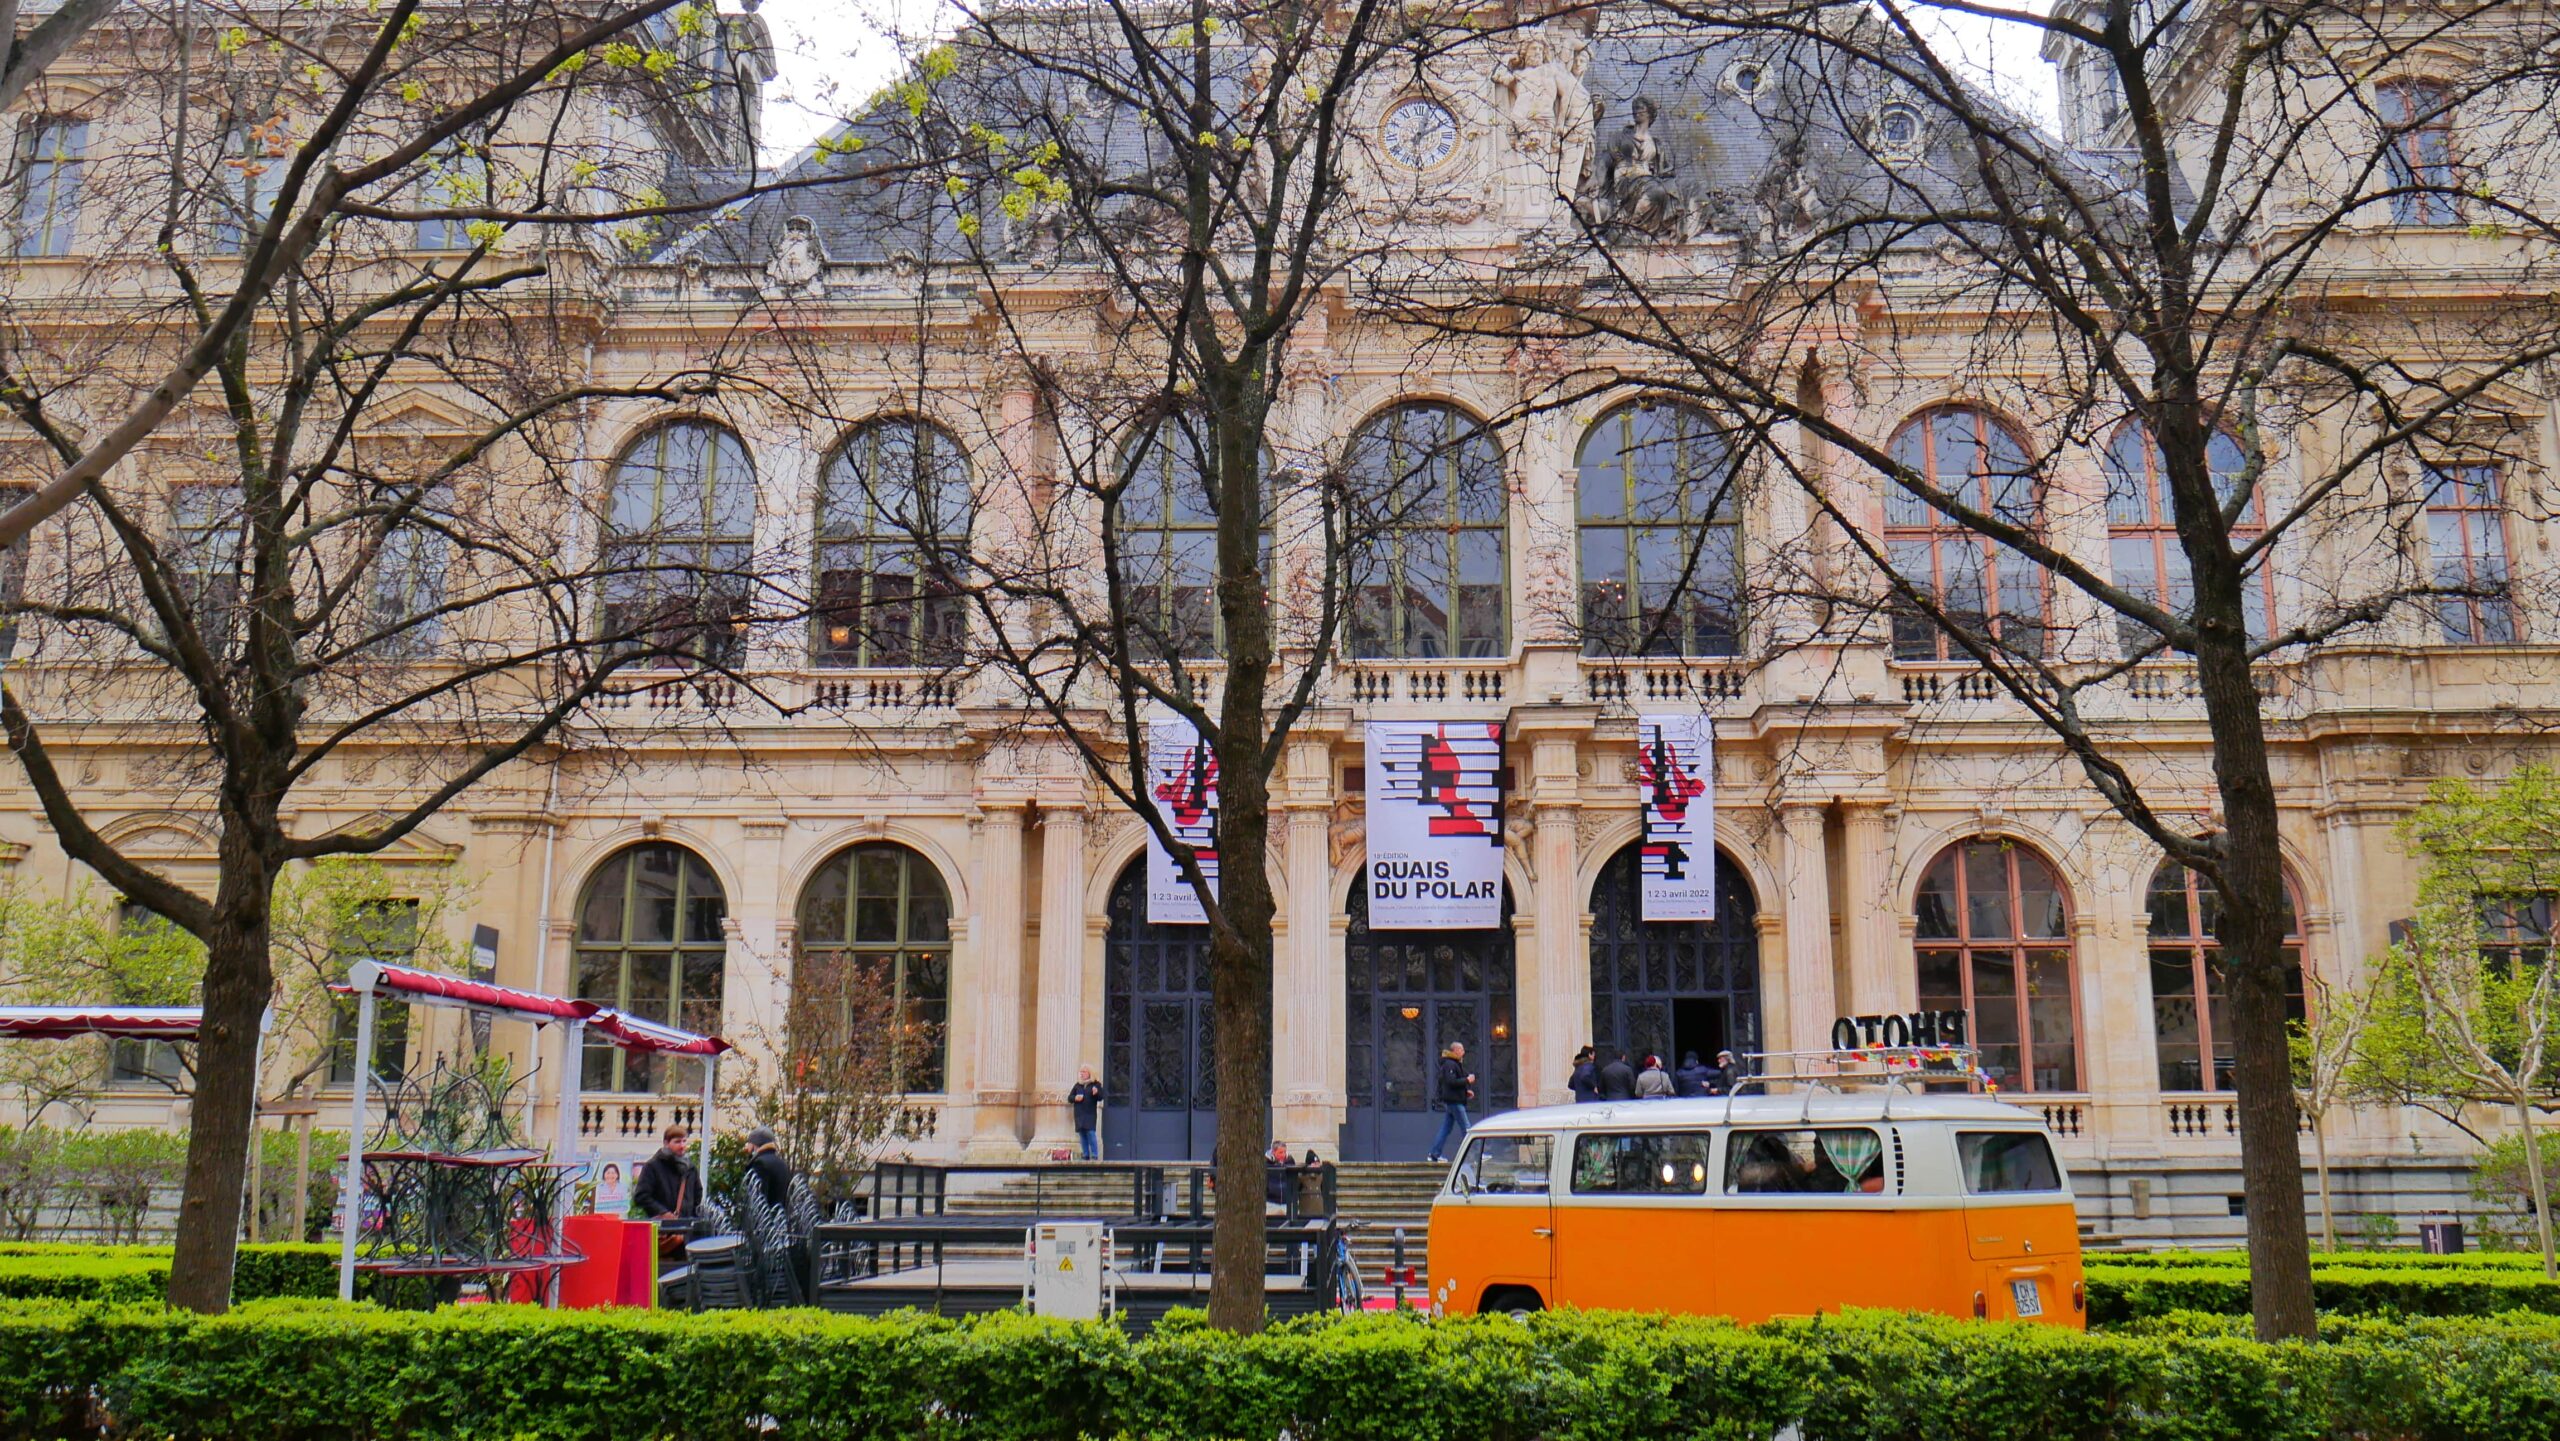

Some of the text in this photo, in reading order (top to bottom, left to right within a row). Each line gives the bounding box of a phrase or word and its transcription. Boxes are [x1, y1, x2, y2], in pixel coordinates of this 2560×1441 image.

[1413, 105, 1425, 117] XII
[1441, 130, 1453, 140] III
[1374, 861, 1449, 880] QUAIS
[1375, 881, 1495, 899] DU POLAR
[1669, 890, 1687, 898] avril
[1689, 890, 1709, 898] 2022
[1173, 893, 1192, 901] avril
